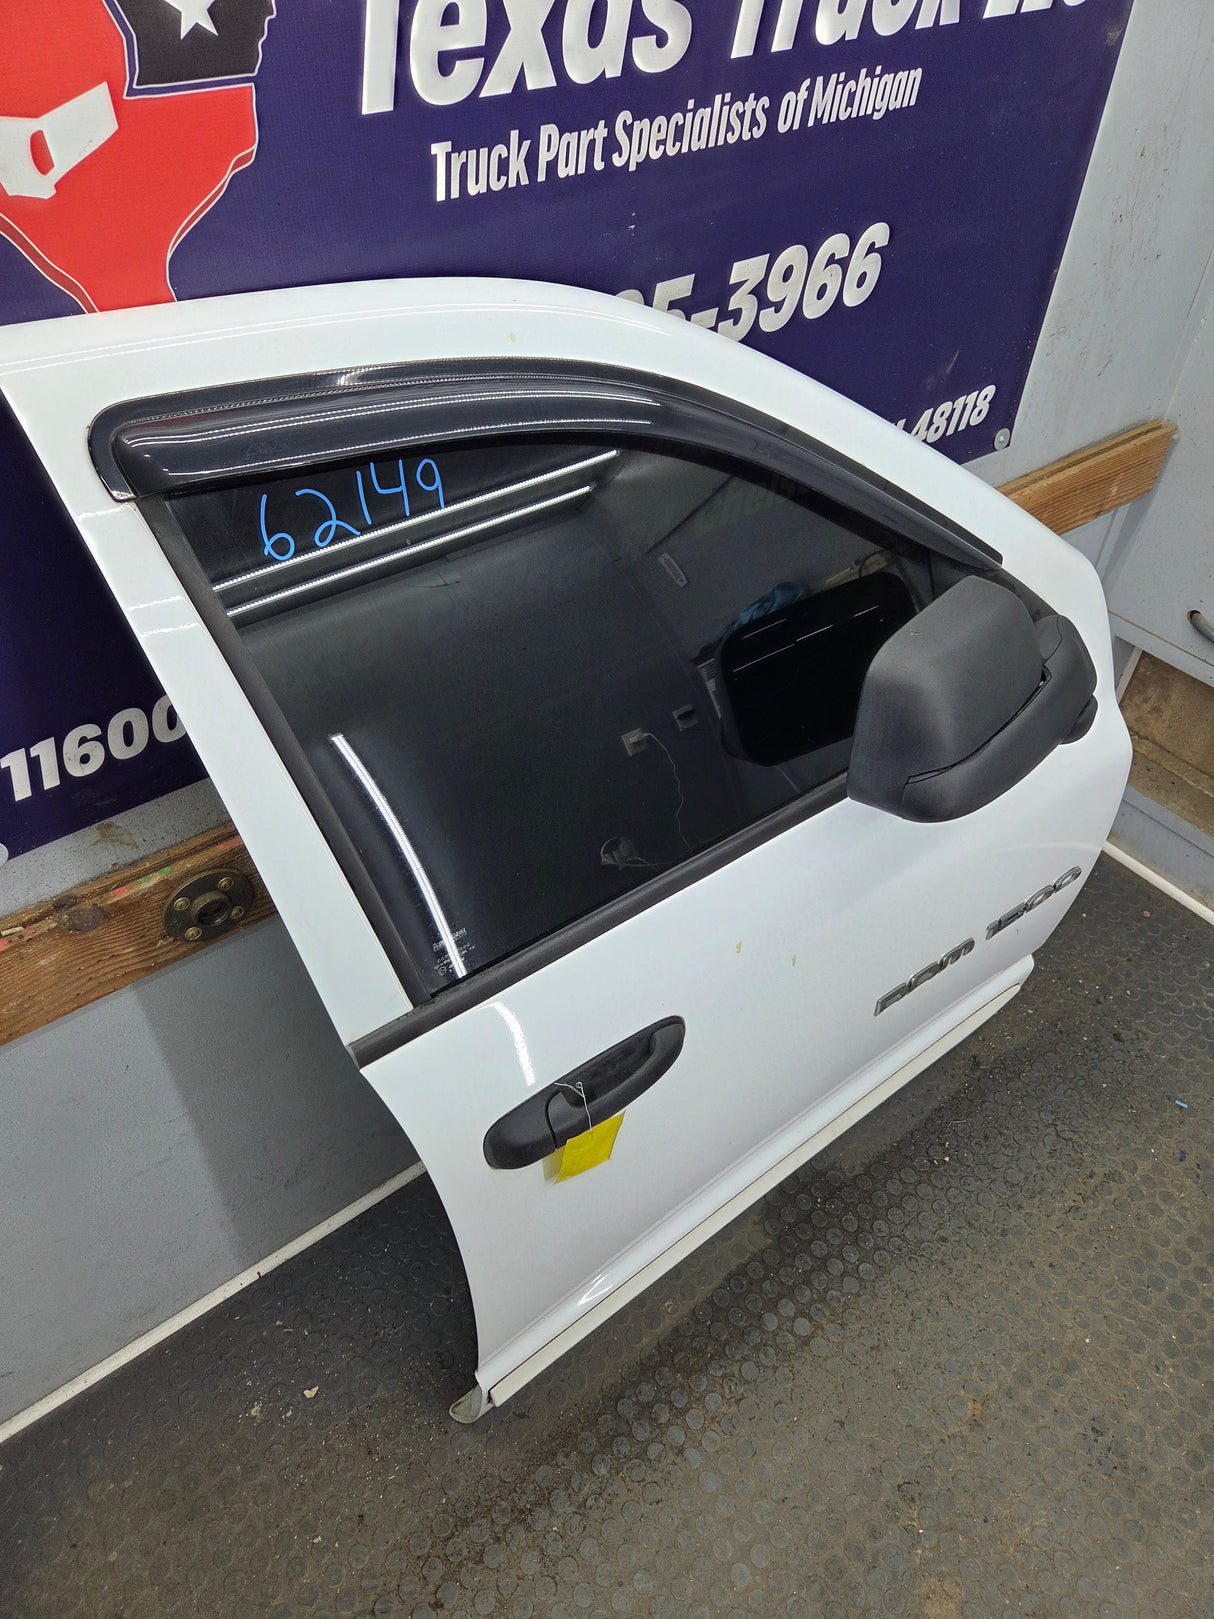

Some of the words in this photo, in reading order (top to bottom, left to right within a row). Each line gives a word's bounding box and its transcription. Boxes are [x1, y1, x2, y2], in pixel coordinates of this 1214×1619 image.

[361, 0, 692, 115] Texas
[430, 129, 531, 202] Truck
[537, 123, 608, 182] Part
[611, 92, 770, 172] Specialists
[777, 78, 811, 133] of
[807, 65, 923, 128] Michigan
[615, 222, 890, 342] 5-3966
[911, 384, 997, 443] 48118
[259, 458, 446, 561] 62149
[0, 694, 188, 802] 11600
[985, 865, 1082, 941] 1500
